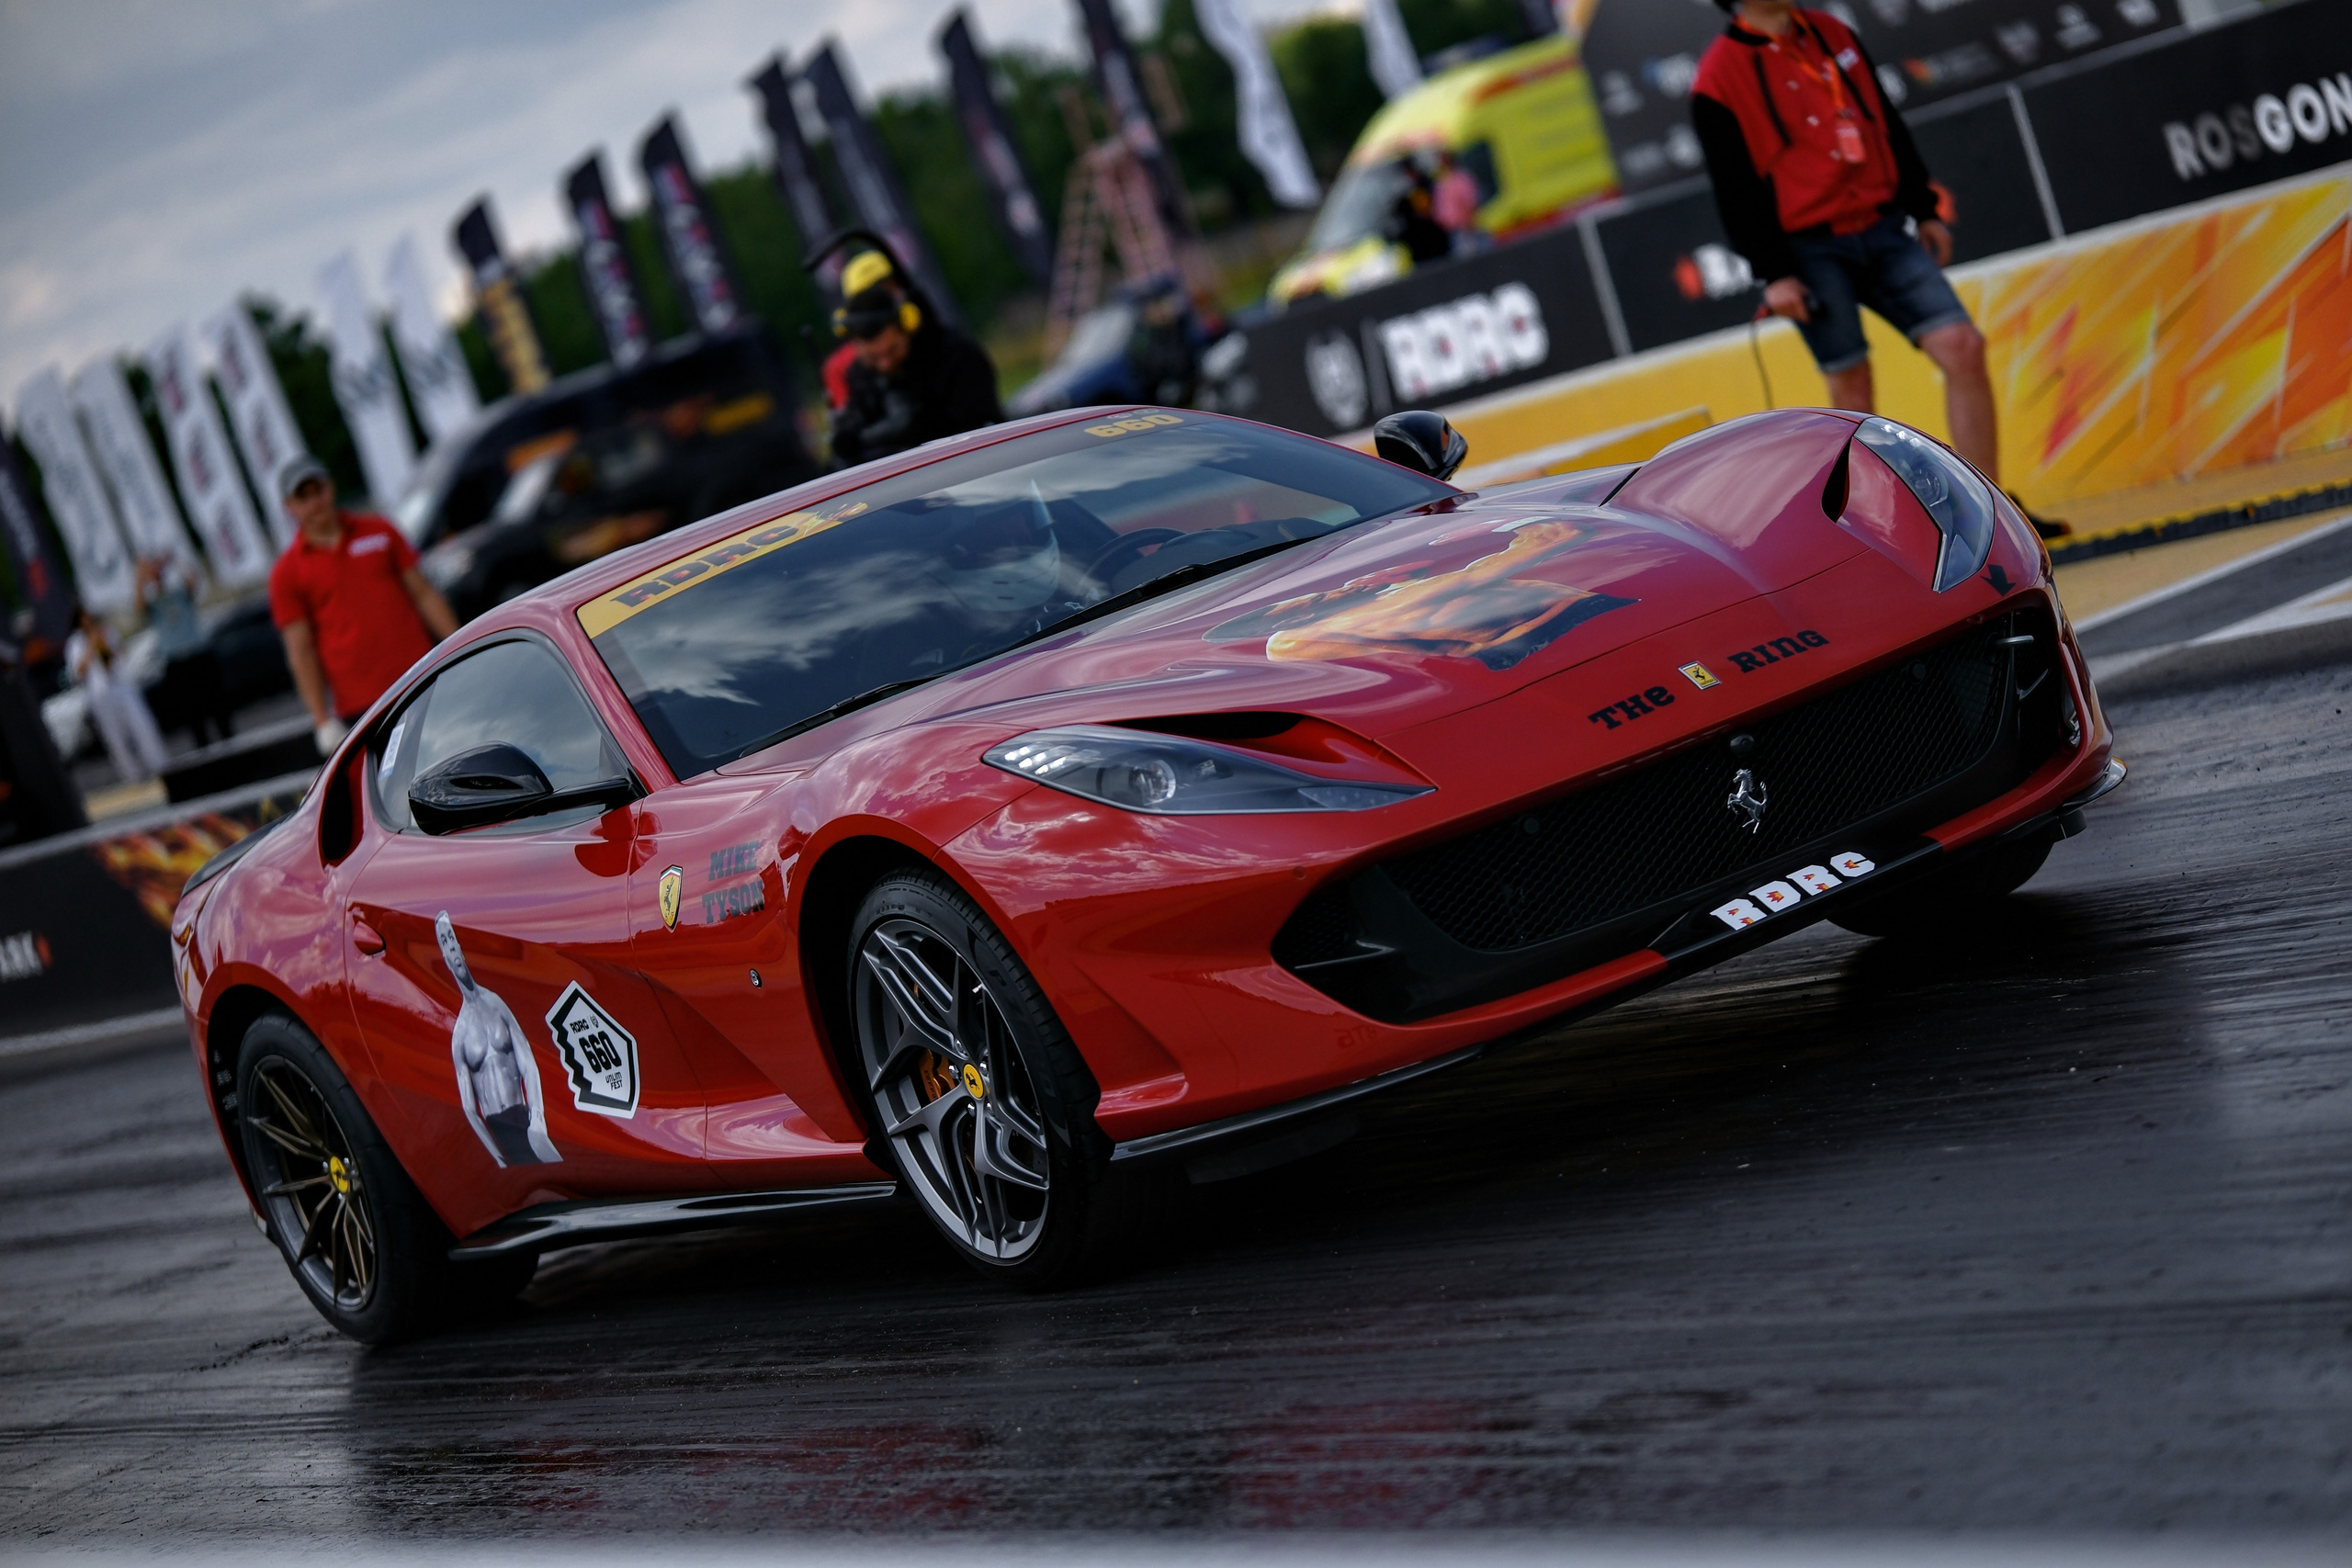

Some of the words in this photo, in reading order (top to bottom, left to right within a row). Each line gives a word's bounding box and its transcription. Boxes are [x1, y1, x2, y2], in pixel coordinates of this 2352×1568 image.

[1084, 414, 1184, 437] 660
[609, 525, 799, 608] RDRC
[707, 840, 760, 881] MIKE
[702, 880, 764, 923] TYSON
[1709, 851, 1876, 931] RDRC
[579, 1031, 622, 1074] 660
[610, 1080, 623, 1090] FEST
